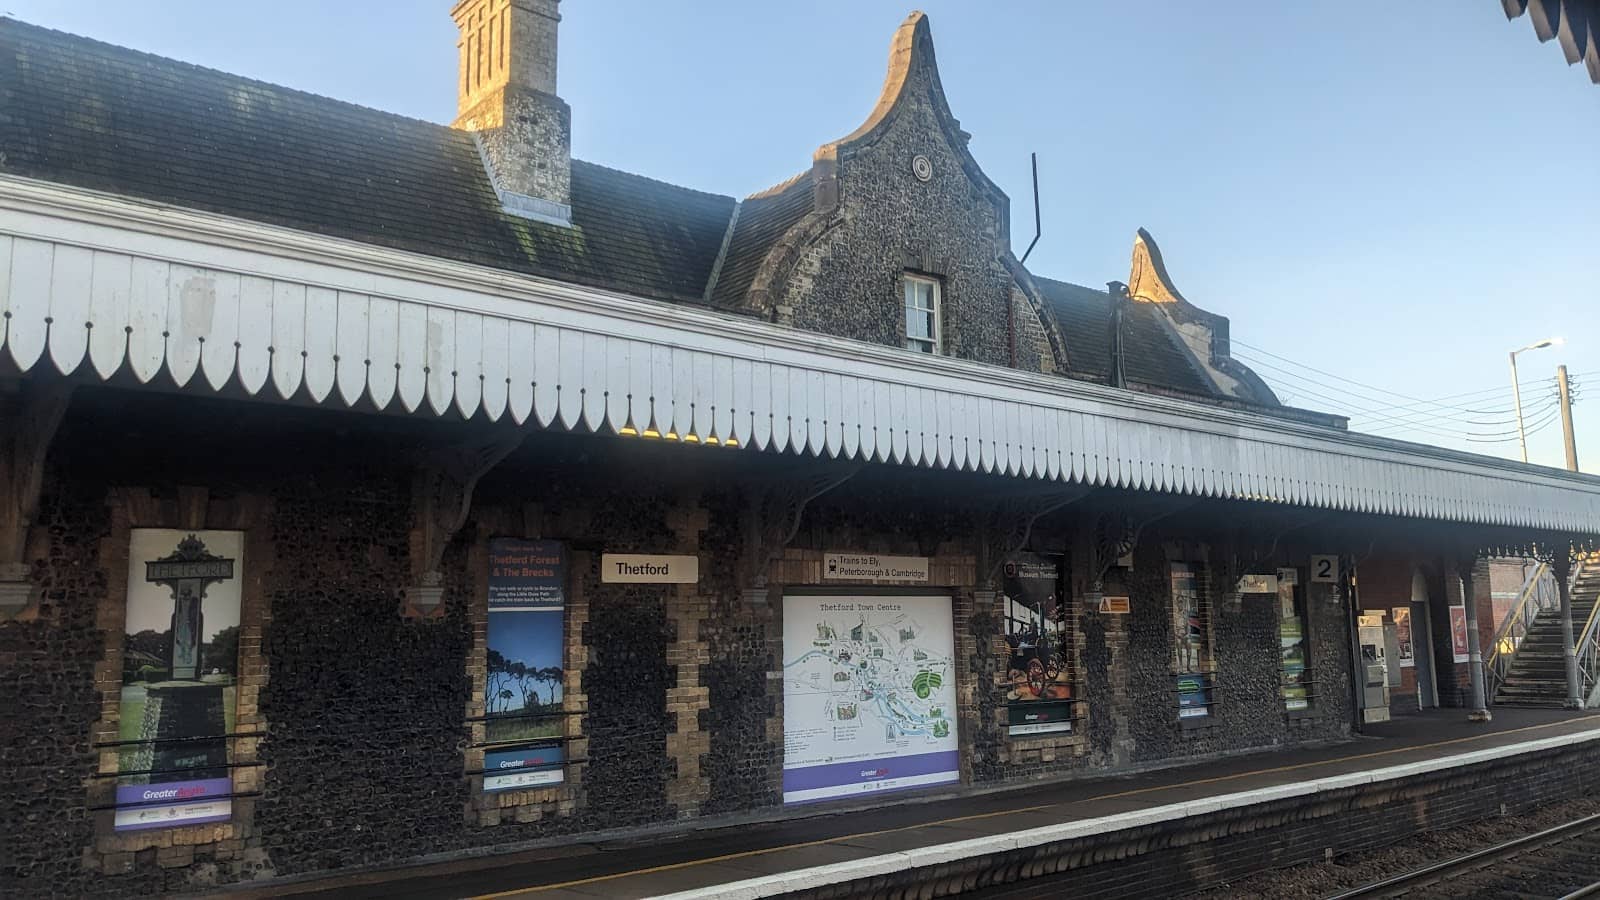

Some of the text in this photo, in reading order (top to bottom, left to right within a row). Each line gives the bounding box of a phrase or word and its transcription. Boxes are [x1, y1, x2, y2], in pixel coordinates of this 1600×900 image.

[488, 555, 560, 565] Thetford Forest
[839, 556, 881, 567] Trains to Ely,
[150, 562, 231, 577] THETFORD
[503, 568, 519, 577] The
[522, 568, 555, 577] Brecks
[615, 562, 669, 575] Thetford
[839, 567, 926, 579] Peterborough & Cambridge
[1318, 559, 1331, 578] 2
[819, 603, 902, 611] Thetford Town Centre
[500, 760, 524, 769] Greater
[143, 789, 178, 800] Greater
